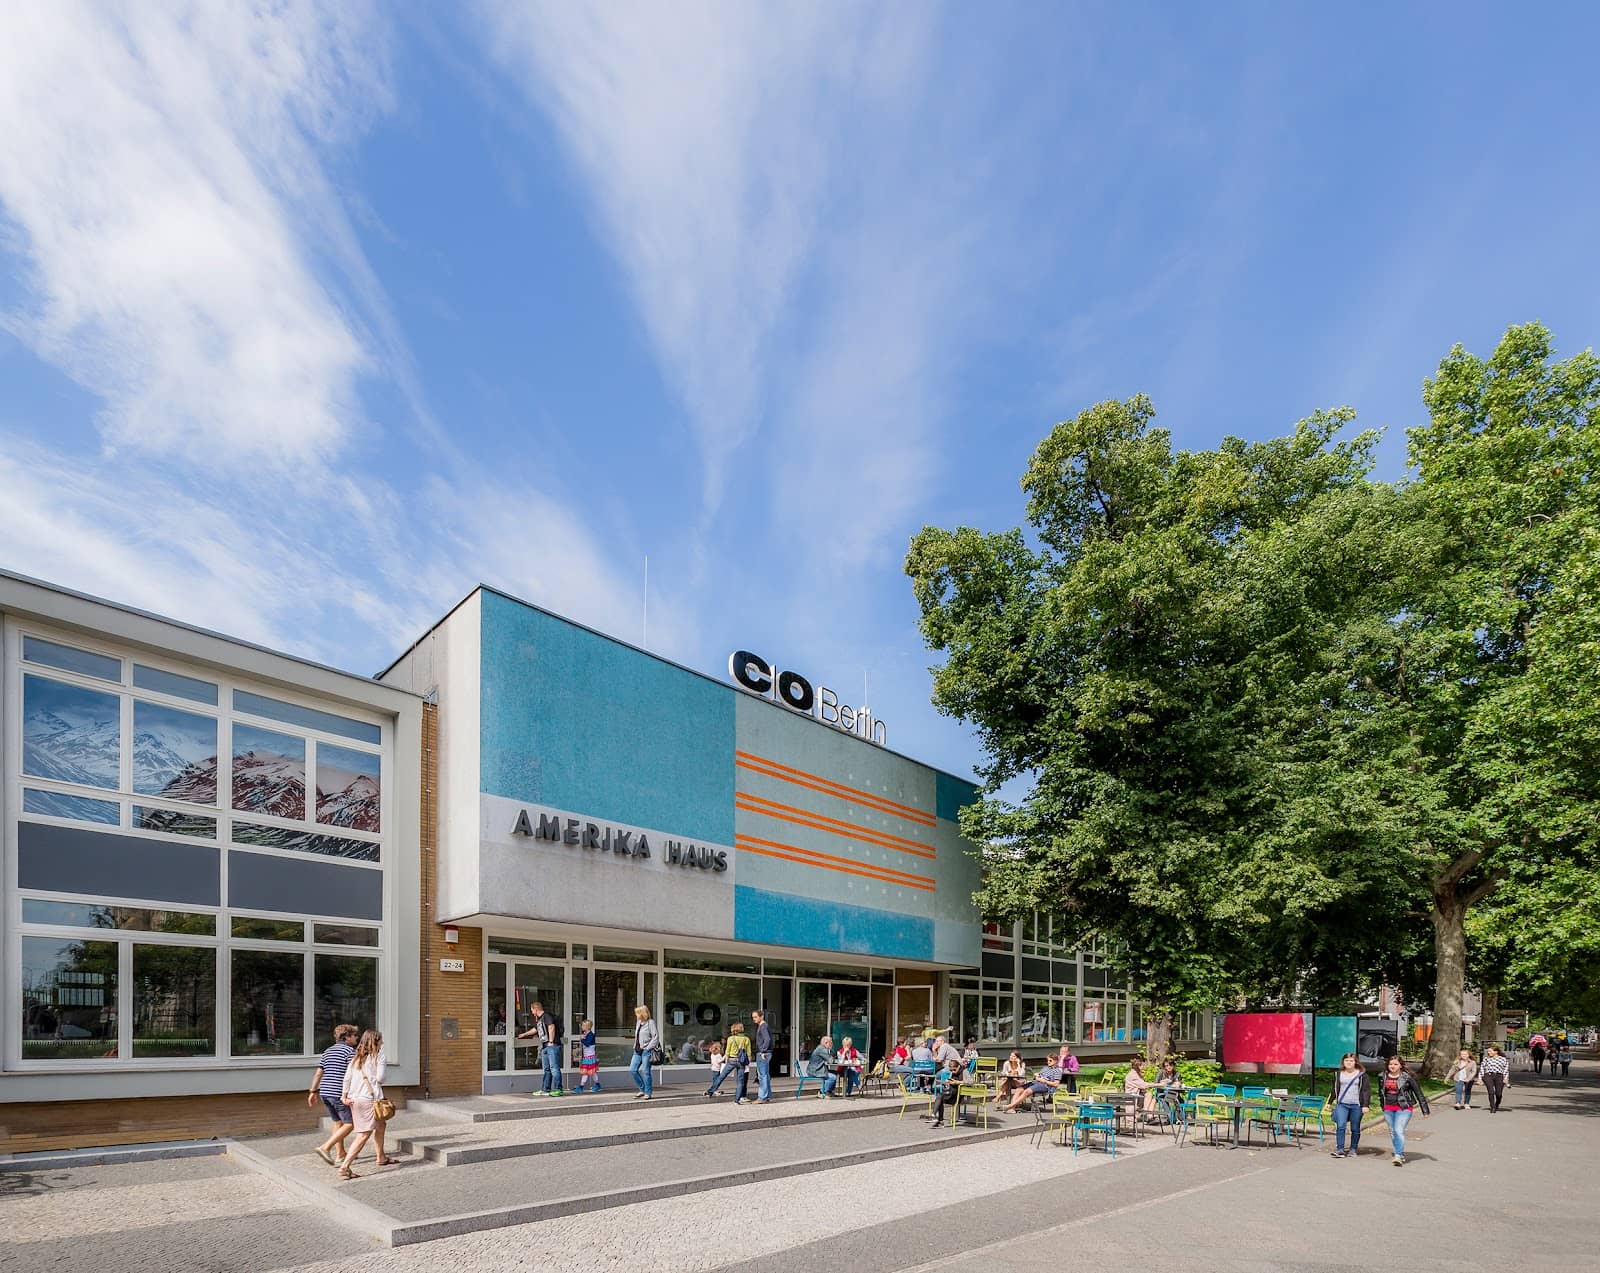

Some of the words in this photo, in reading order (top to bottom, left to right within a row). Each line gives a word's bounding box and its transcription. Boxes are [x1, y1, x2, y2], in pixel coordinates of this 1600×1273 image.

[818, 686, 887, 745] Berlin
[511, 809, 651, 859] AMERIKA
[665, 840, 728, 873] HAUS
[443, 961, 463, 969] 22-24
